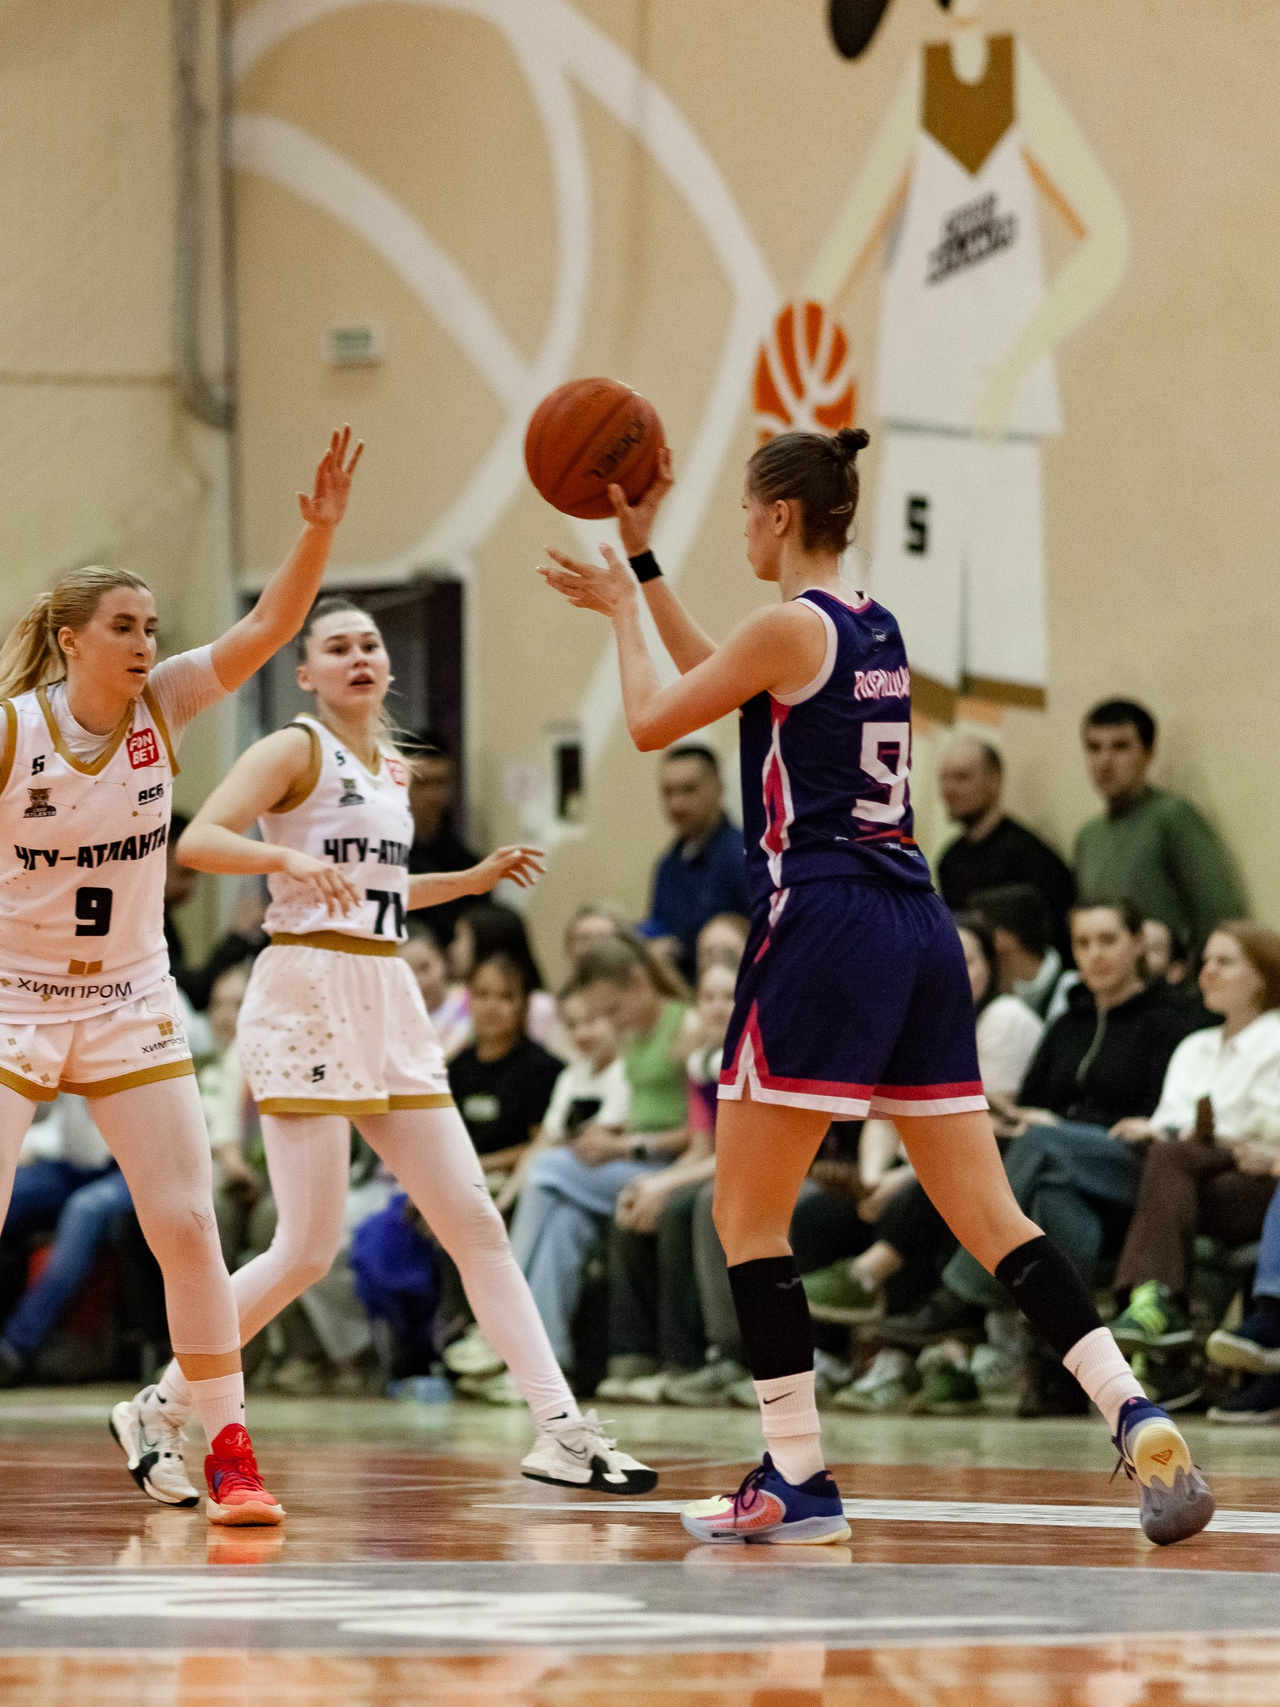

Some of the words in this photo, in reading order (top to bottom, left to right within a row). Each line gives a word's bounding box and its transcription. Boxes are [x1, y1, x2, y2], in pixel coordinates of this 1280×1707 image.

[132, 744, 156, 765] BET
[851, 721, 911, 826] 9
[13, 823, 167, 871] ЧГУ-АТЛАНТА
[75, 886, 114, 937] 9
[17, 977, 133, 999] ХИМПРОМ
